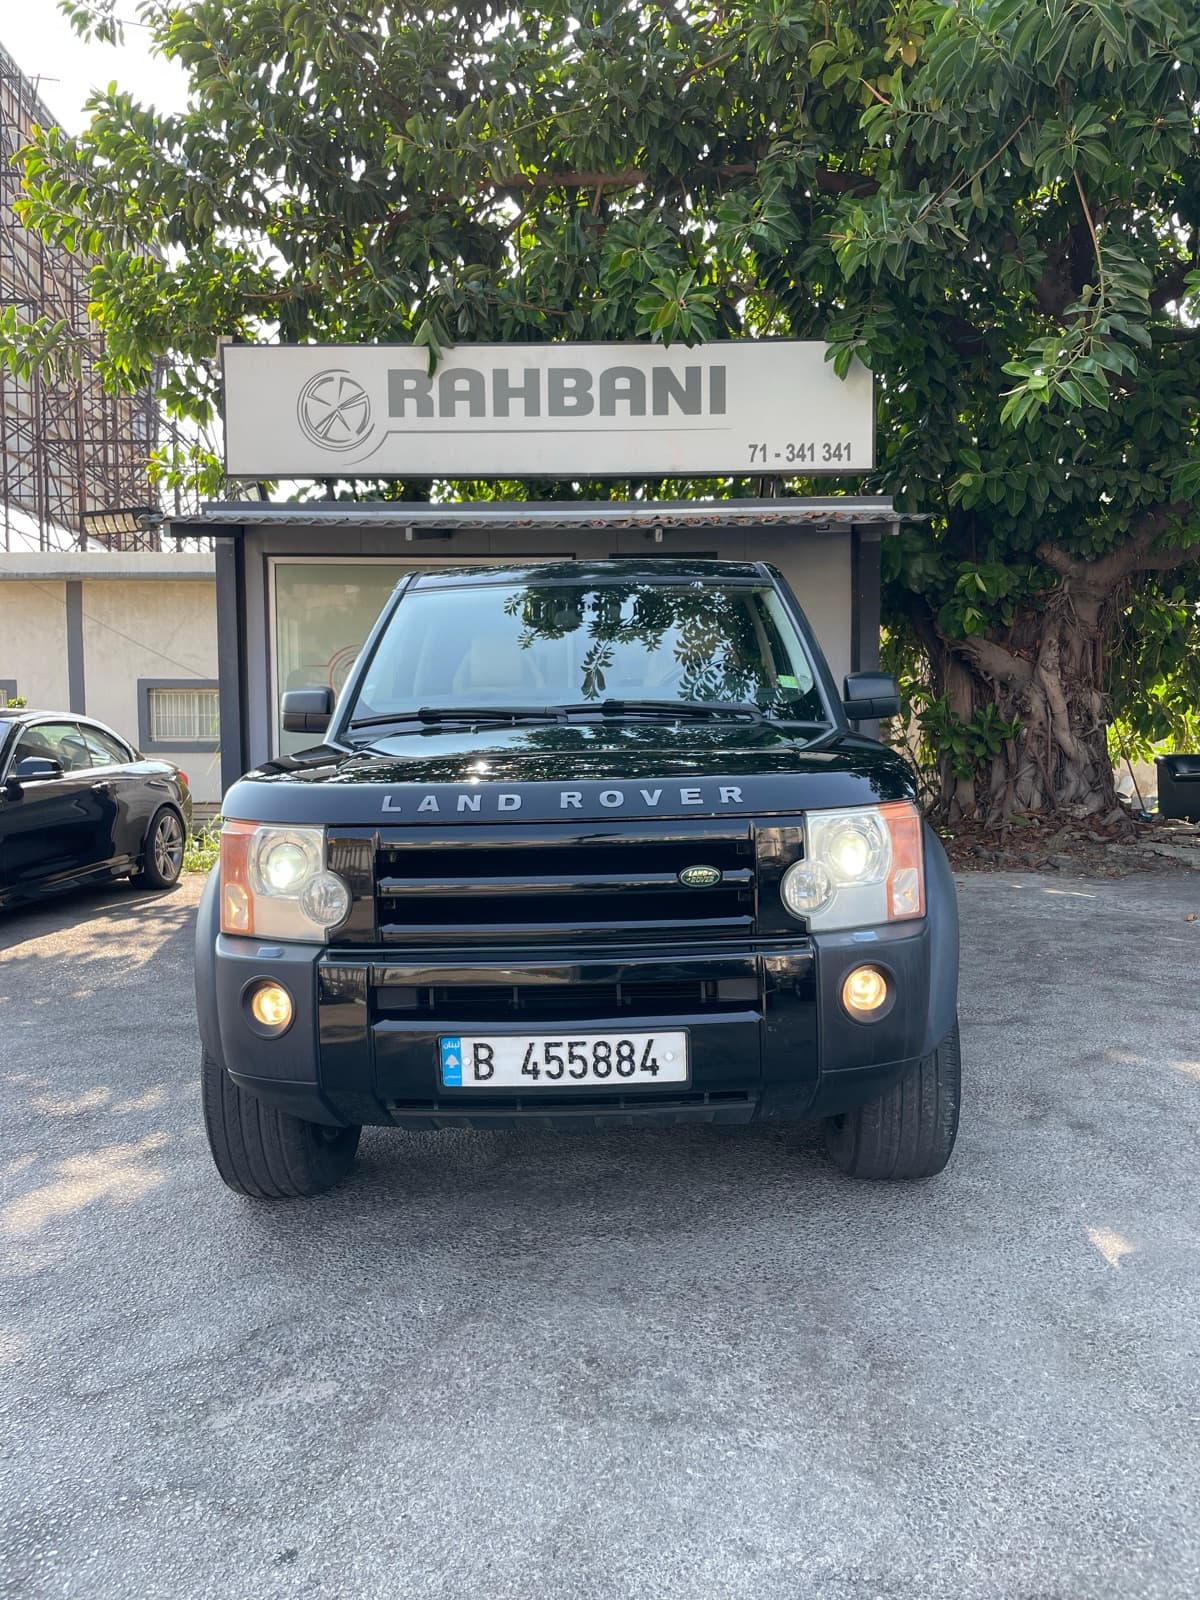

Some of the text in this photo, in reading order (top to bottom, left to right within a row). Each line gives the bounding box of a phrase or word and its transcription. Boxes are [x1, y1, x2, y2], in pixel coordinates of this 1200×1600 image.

[387, 365, 727, 418] RAHBANI
[748, 443, 767, 463] 71
[786, 442, 815, 462] 341
[822, 442, 851, 461] 341
[381, 786, 744, 813] LAND ROVER
[473, 1039, 660, 1080] B 455884
